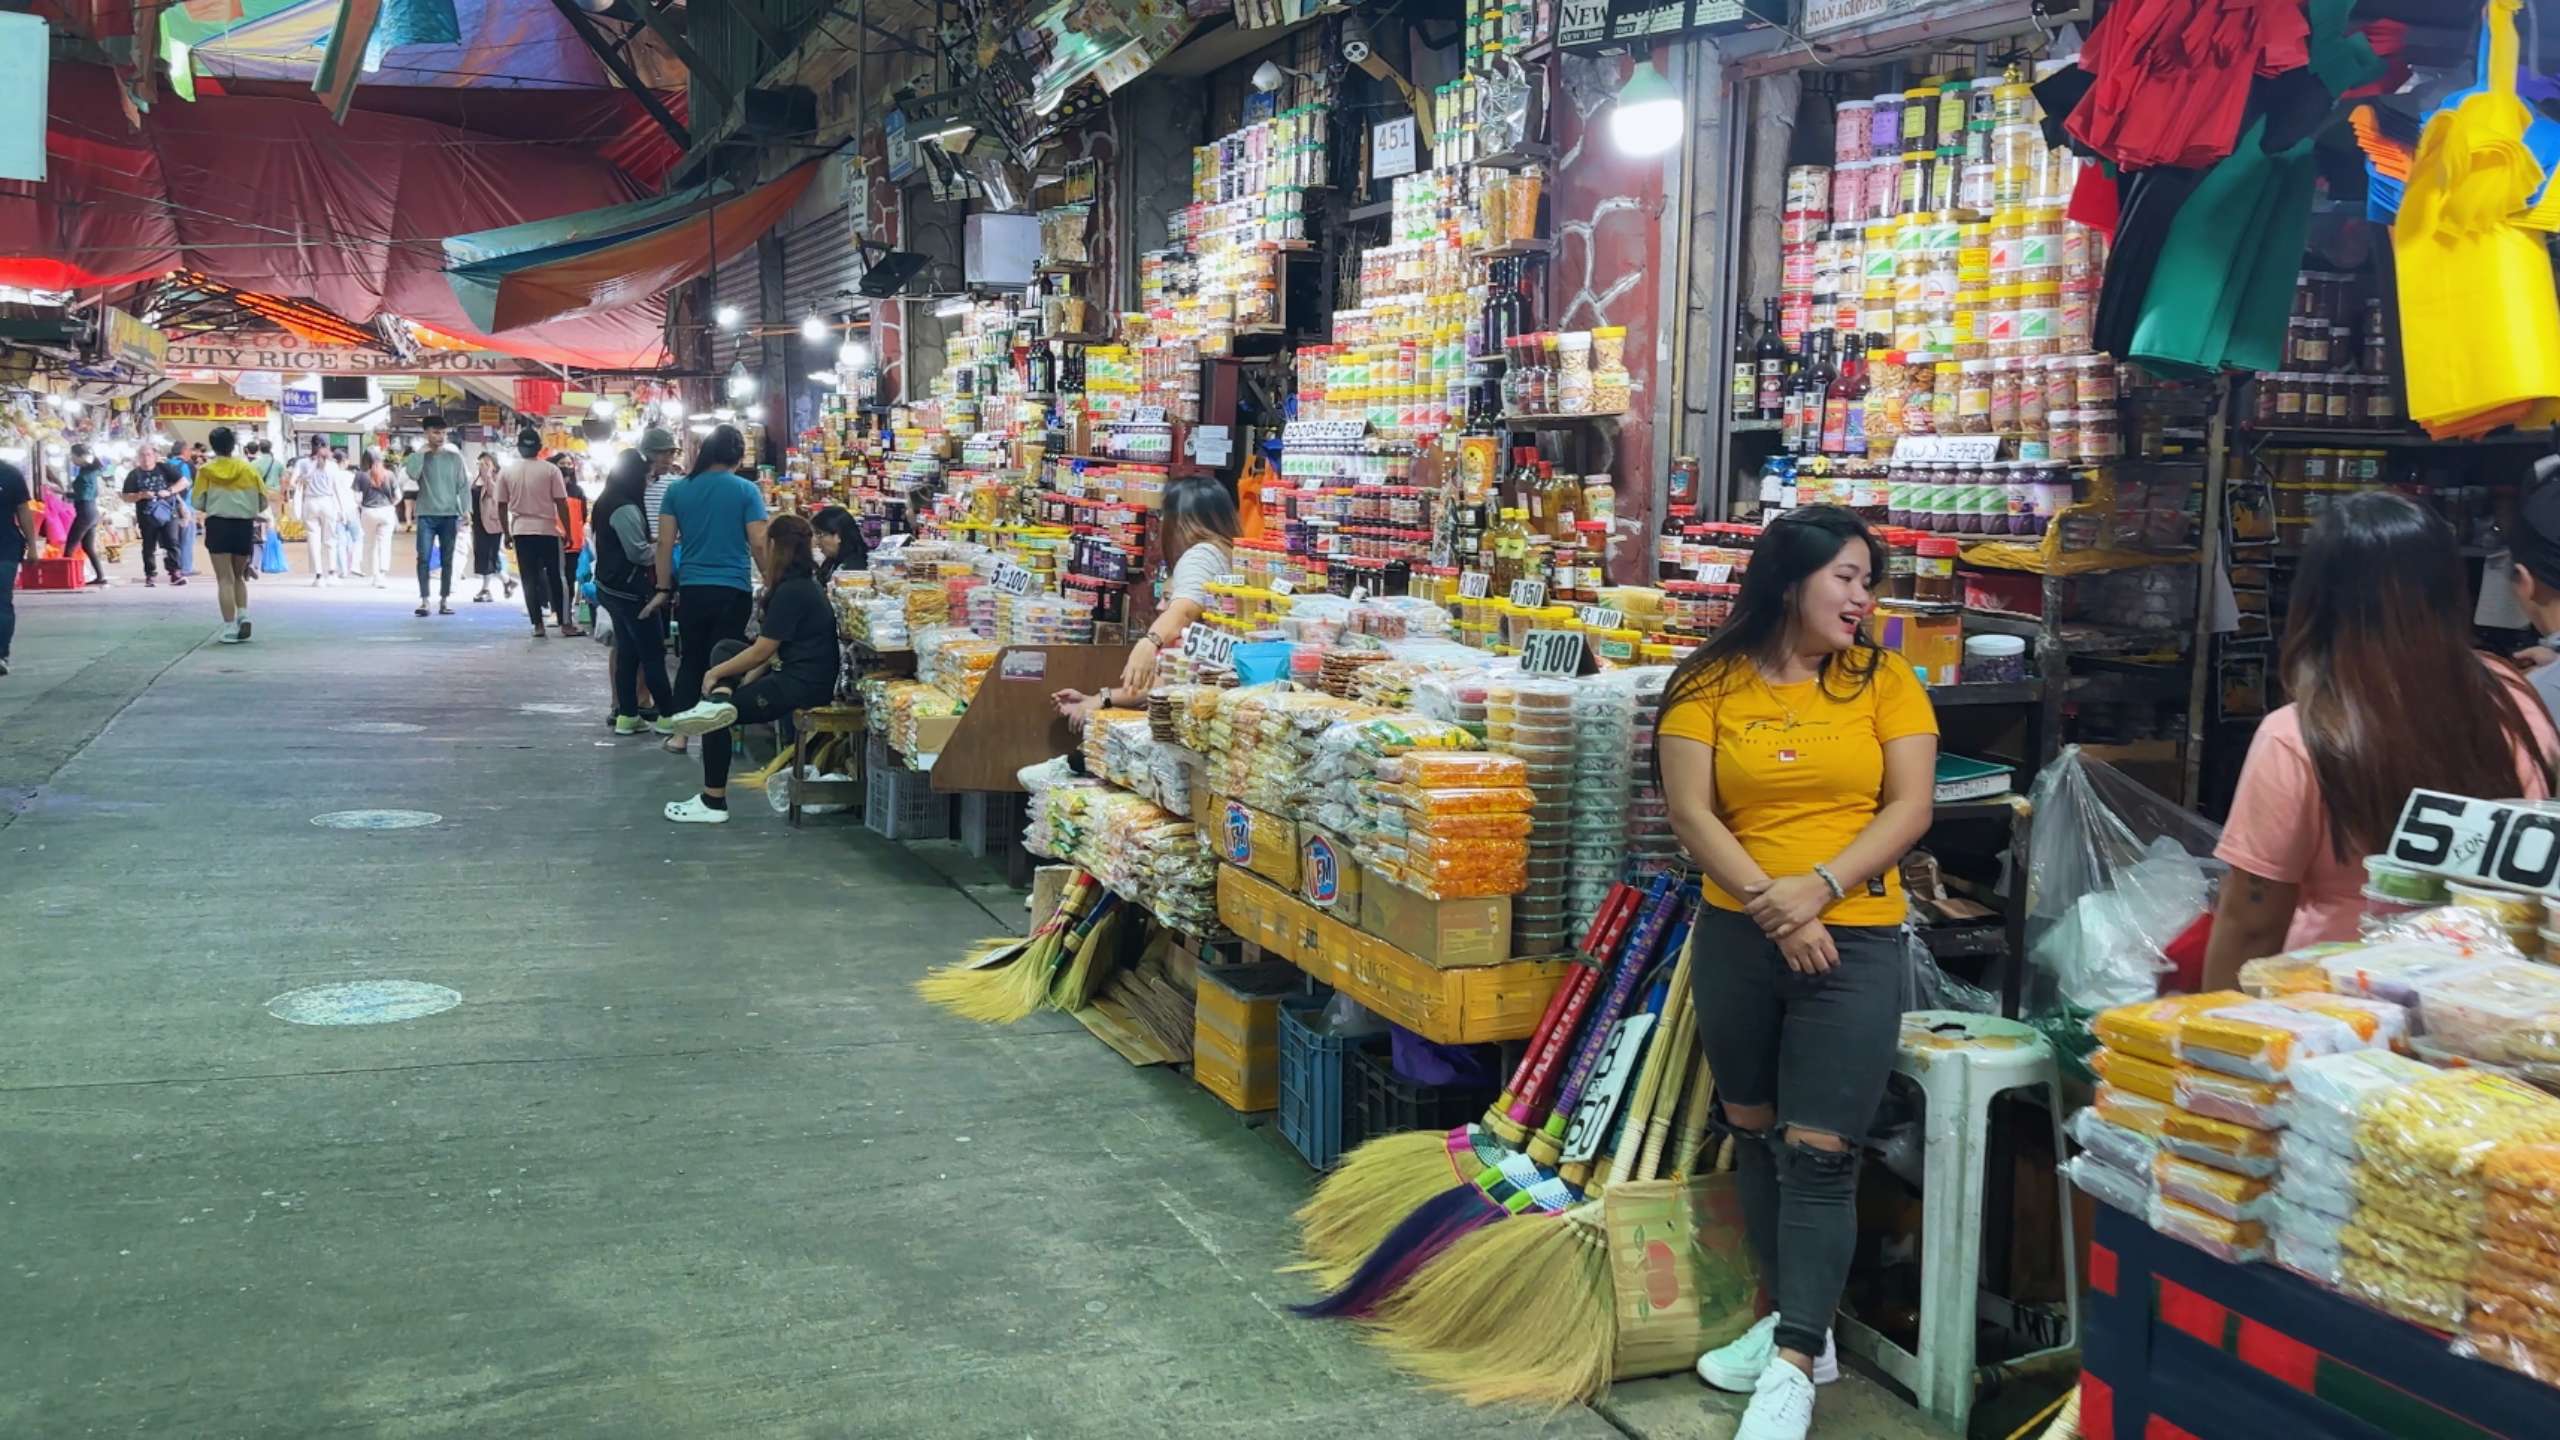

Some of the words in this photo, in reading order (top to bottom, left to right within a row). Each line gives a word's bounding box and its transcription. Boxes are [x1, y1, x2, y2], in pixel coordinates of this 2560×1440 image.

[1378, 122, 1410, 151] 451
[166, 346, 242, 367] CITY
[257, 350, 338, 370] RICE
[350, 352, 497, 370] SETION
[1006, 570, 1028, 591] 100
[1511, 581, 1520, 603] 3
[1523, 583, 1542, 606] 150
[1582, 607, 1591, 624] 3
[1597, 611, 1618, 627] 100
[1184, 626, 1202, 656] 5
[1209, 637, 1233, 664] 10
[1521, 634, 1538, 670] 5
[1542, 634, 1580, 673] 100
[2395, 793, 2467, 866] 5
[2477, 808, 2560, 888] 10
